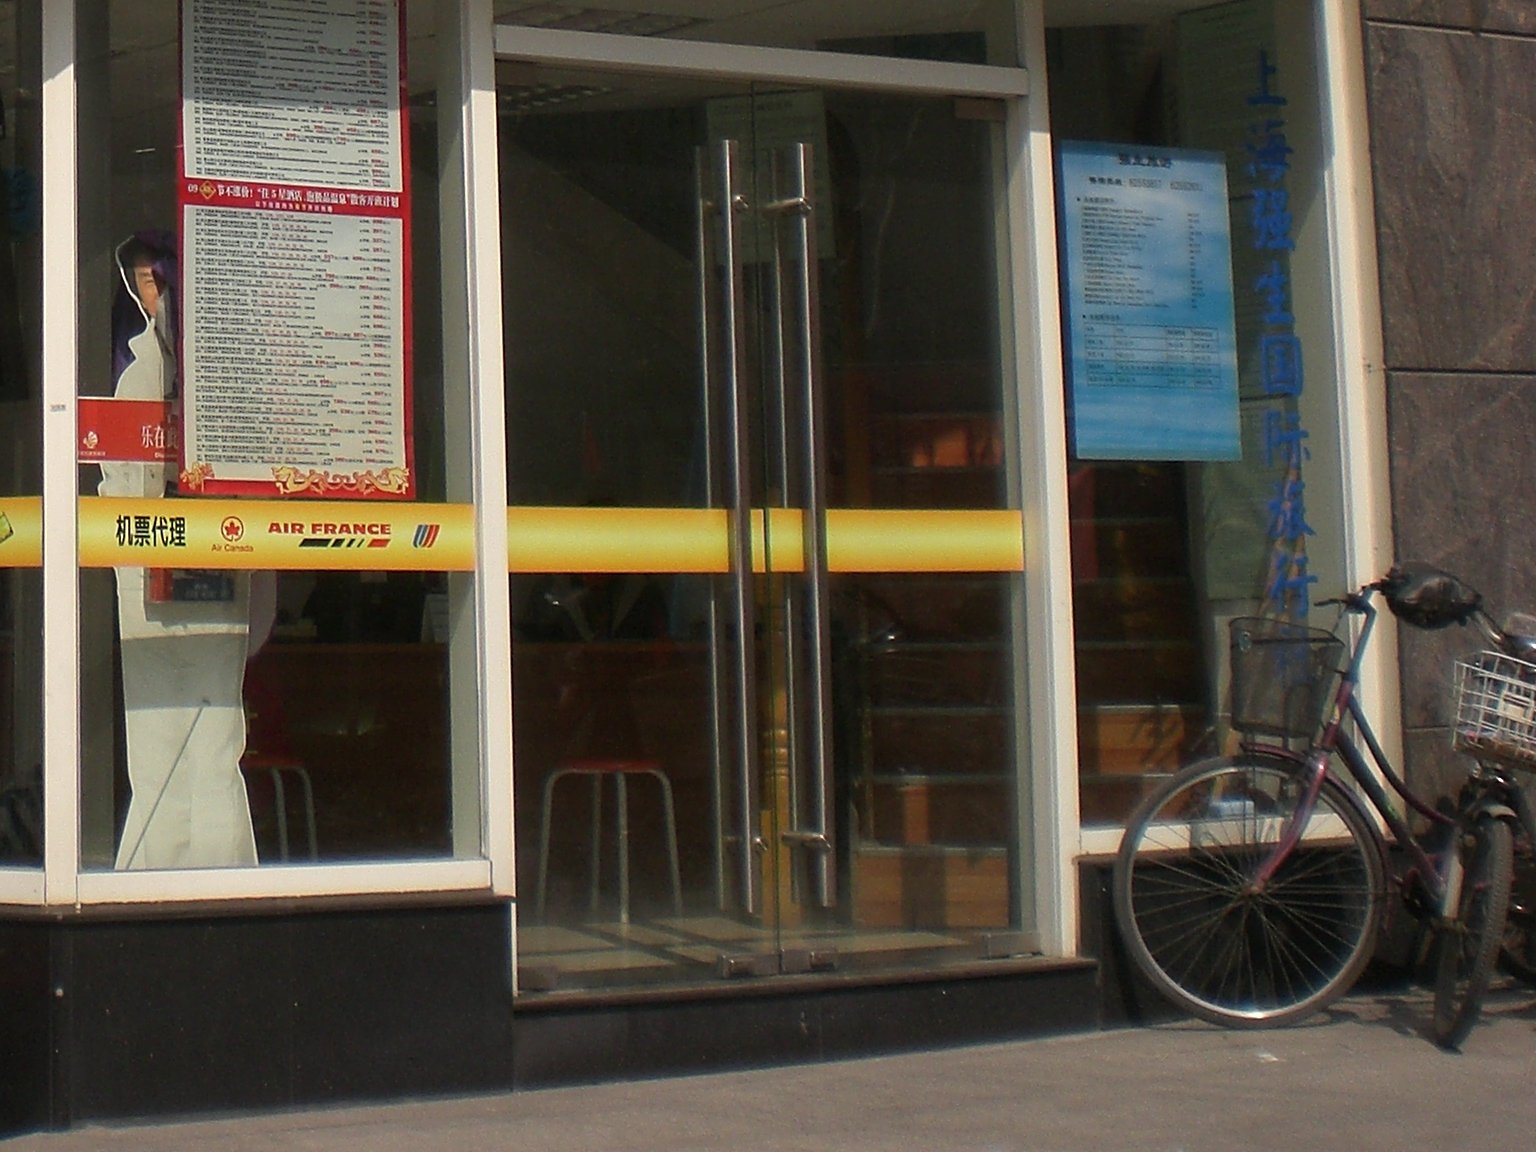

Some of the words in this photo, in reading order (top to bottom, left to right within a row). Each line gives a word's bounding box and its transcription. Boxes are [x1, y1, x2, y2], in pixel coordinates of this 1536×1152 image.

[116, 515, 186, 547] 机票代理
[268, 523, 306, 535] AIR
[311, 523, 391, 535] FRANCE
